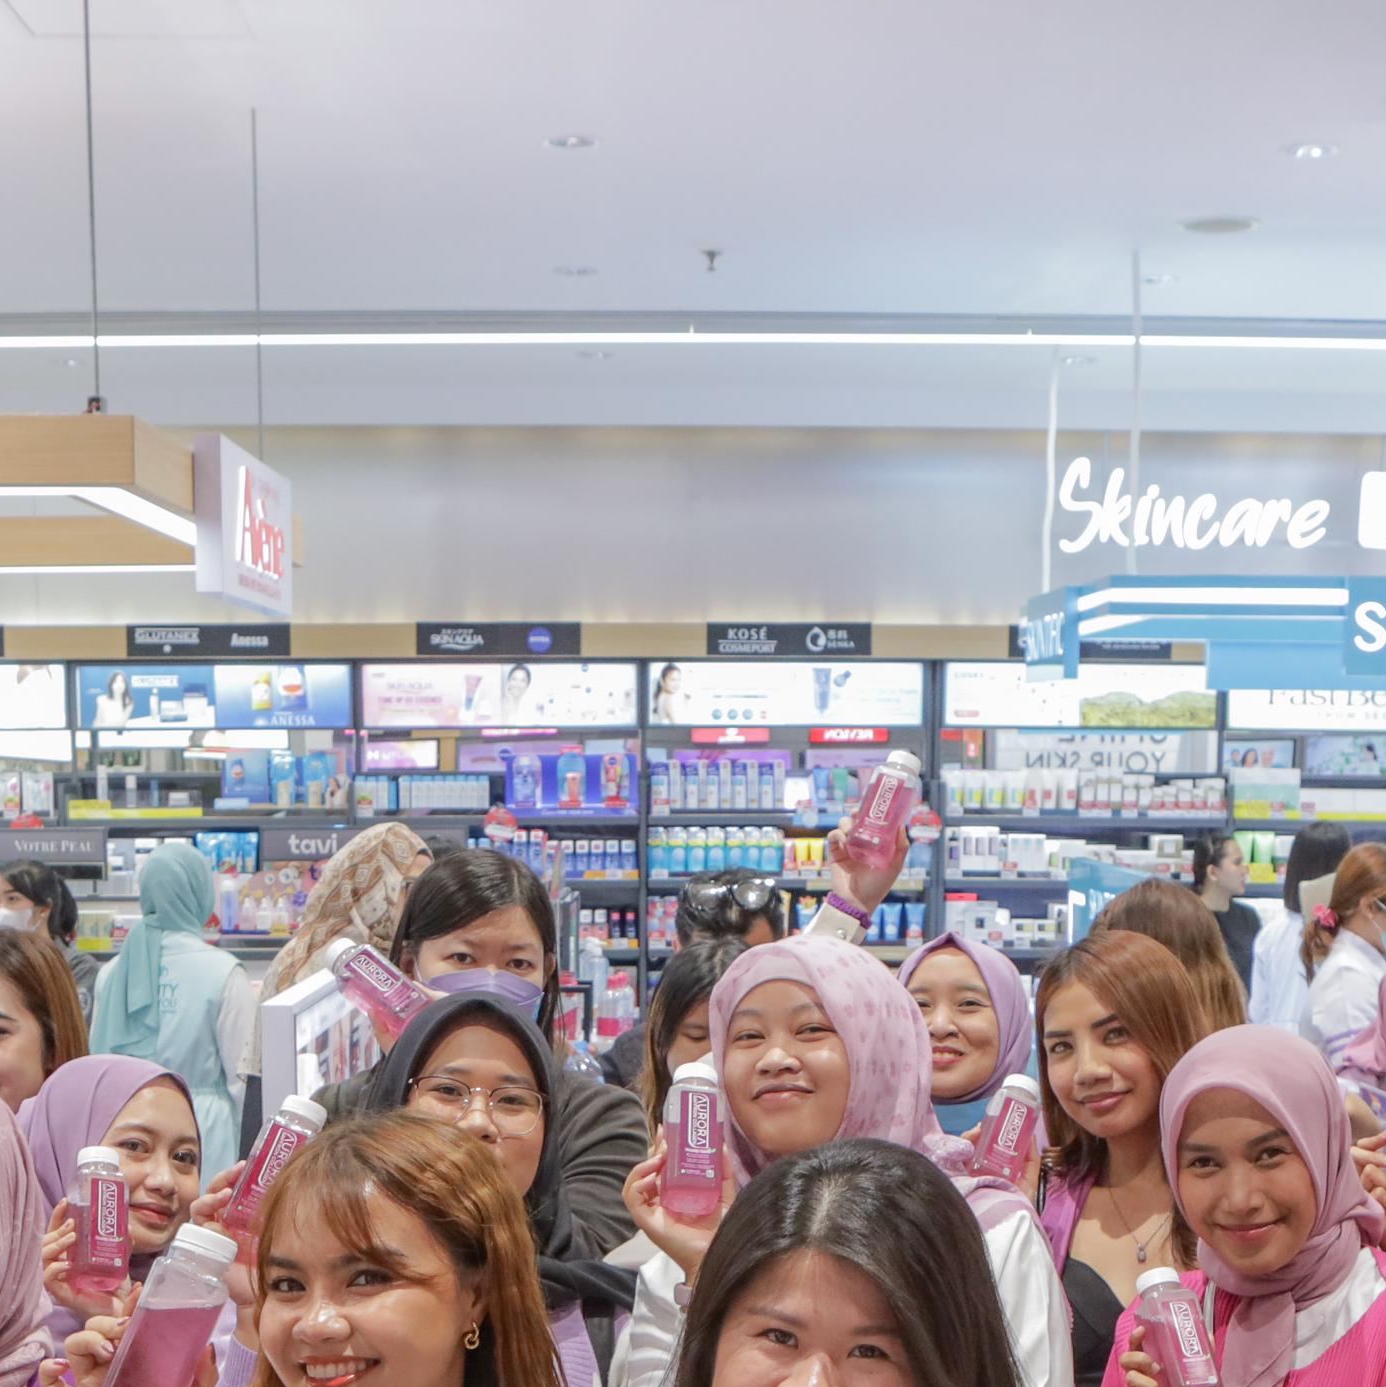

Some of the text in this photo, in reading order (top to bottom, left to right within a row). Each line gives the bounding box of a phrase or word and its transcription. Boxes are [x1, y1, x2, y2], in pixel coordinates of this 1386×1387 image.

[1059, 456, 1331, 553] Skincare
[135, 630, 199, 642] GLUTANEX
[728, 627, 768, 640] KOSÉ
[270, 715, 315, 726] ANESSA
[289, 833, 338, 857] tavi
[359, 955, 393, 988] AURORA
[696, 1095, 708, 1146] AURORA
[1002, 1105, 1027, 1149] AURORA
[104, 1182, 115, 1235] AURORA
[1176, 1303, 1200, 1356] AURORA
